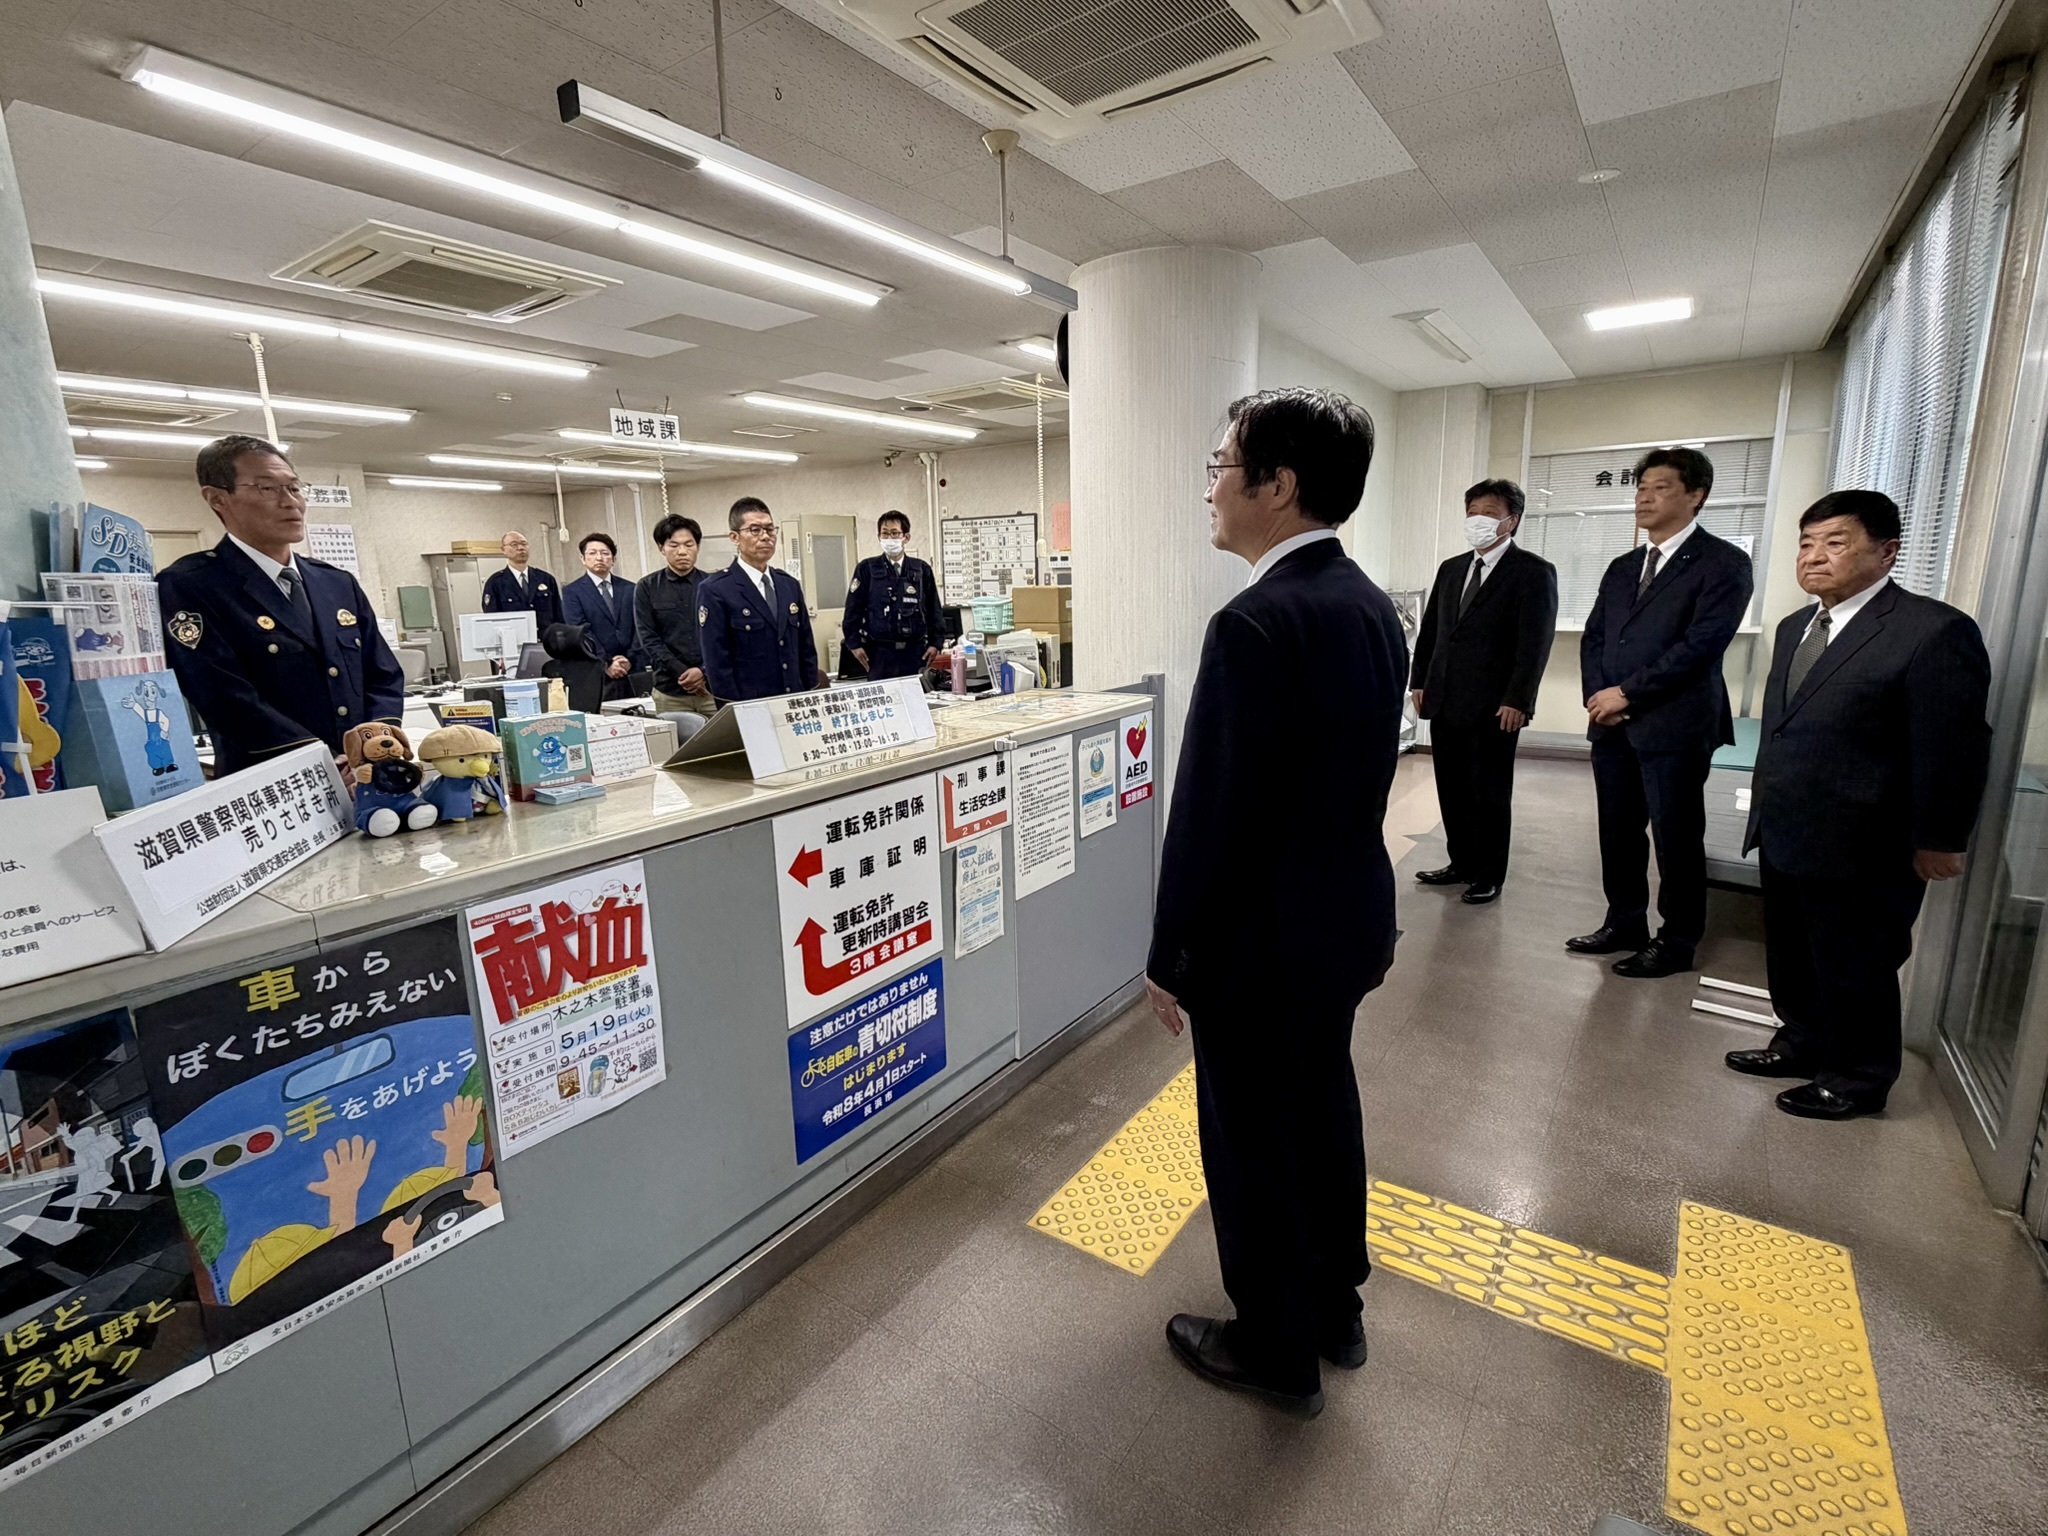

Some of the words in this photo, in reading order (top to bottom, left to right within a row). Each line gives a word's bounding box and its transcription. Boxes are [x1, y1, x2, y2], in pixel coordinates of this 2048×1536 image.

[614, 415, 677, 441] 地域課
[304, 488, 350, 503] 務課
[792, 719, 823, 737] 受付は
[831, 706, 894, 729] 終了致しました
[821, 725, 874, 745] 受付時間(平日)
[957, 760, 1006, 789] 刑事課
[1125, 760, 1148, 780] AED
[133, 760, 330, 871] 滋賀県警察関係事務手数料
[240, 785, 342, 853] 売りさばき所
[826, 795, 925, 845] 運転免許関係
[959, 786, 1007, 817] 生活安全課
[962, 818, 992, 836] 2階へ
[196, 837, 312, 917] 公益財団法人滋賀県交通安全協会
[312, 830, 328, 847] 会長
[829, 836, 927, 889] 車庫証明
[833, 892, 895, 935] 運転免許
[841, 900, 930, 957] 更新時講習会
[473, 897, 648, 1026] 献血
[850, 931, 918, 975] 3階会議室
[239, 949, 391, 1014] 車から
[552, 975, 641, 1021] 木之本警察署
[614, 984, 654, 1012] 駐車場
[167, 967, 458, 1085] ぼくたちみえない
[561, 1004, 651, 1050] 5月19日(火)
[809, 972, 929, 1046] 注意だけではありません
[826, 987, 938, 1074] 自転車の青切符制度
[507, 1022, 550, 1046] 受付場所
[512, 1045, 552, 1068] 実施日
[609, 1034, 657, 1058] 予約はこちらから
[512, 1065, 556, 1088] 受付時間
[822, 1052, 928, 1127] 令和8年4月1日スタート
[843, 1042, 907, 1091] はじまります
[284, 1048, 479, 1142] 手をあげよう
[863, 1090, 894, 1118] 長浜市
[3, 1295, 90, 1357] ほど
